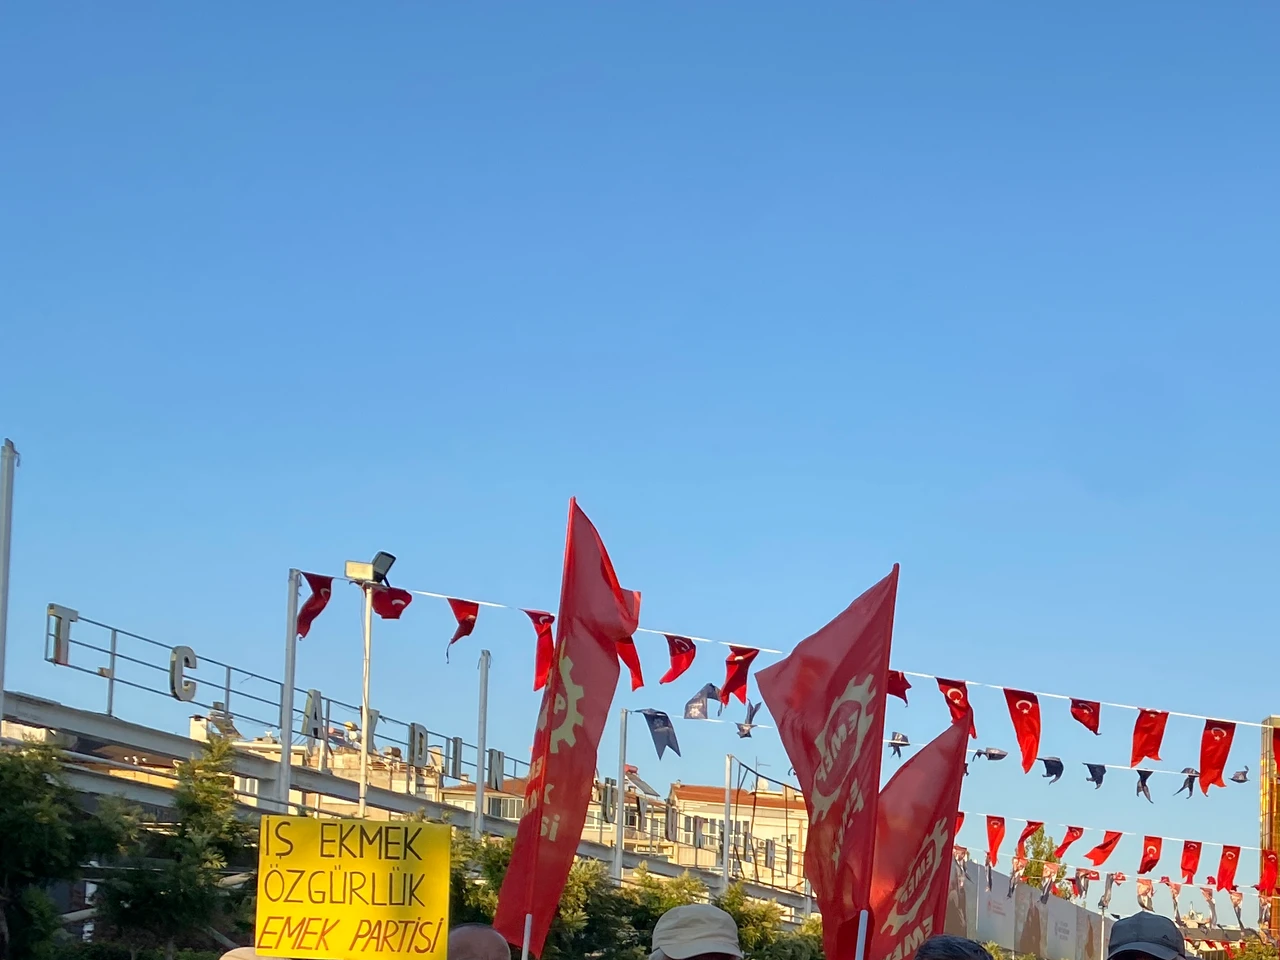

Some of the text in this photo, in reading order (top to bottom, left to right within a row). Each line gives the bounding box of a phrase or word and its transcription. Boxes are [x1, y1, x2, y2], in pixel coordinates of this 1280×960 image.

[265, 814, 423, 861] İŞ EKMEK
[264, 864, 426, 908] ÖZGÜRLÜK
[257, 916, 444, 954] EMEK PARTİSİ
